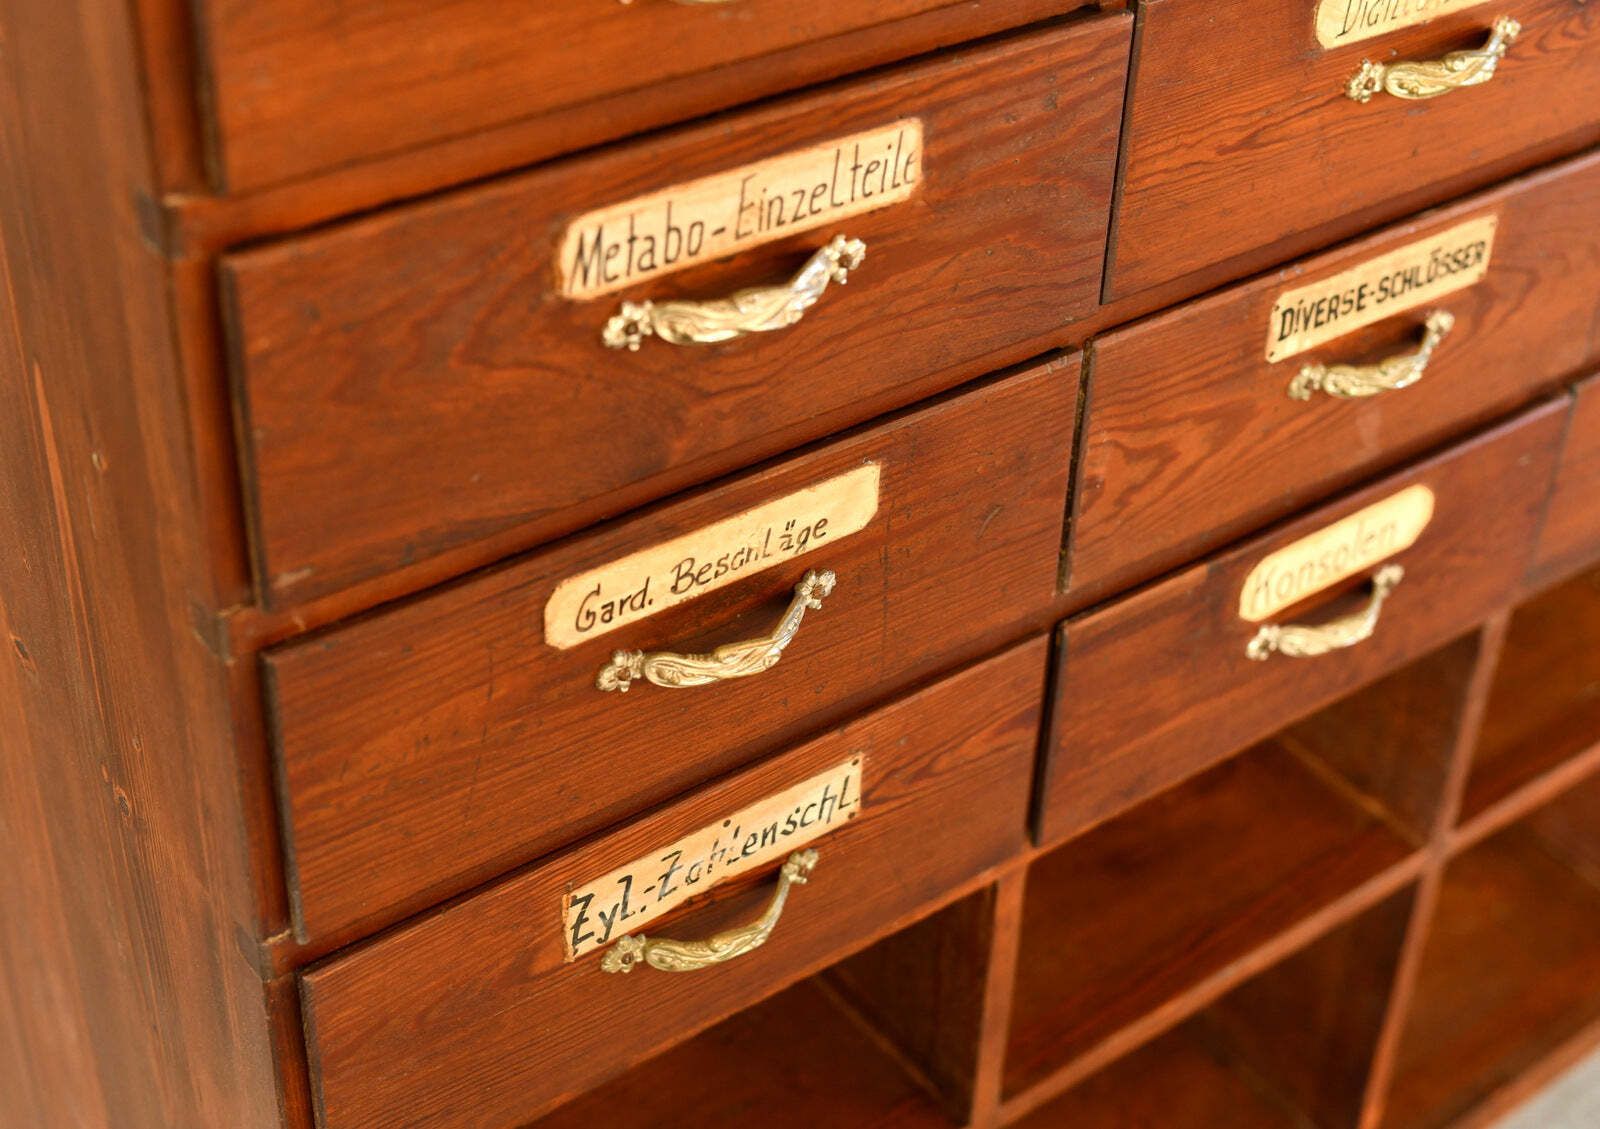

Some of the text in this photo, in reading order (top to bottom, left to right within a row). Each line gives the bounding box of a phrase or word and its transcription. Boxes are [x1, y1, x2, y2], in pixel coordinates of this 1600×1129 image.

[569, 130, 917, 293] Metabo-Einzelteile
[575, 576, 654, 633] Gard.
[1249, 518, 1398, 616] Konsolen
